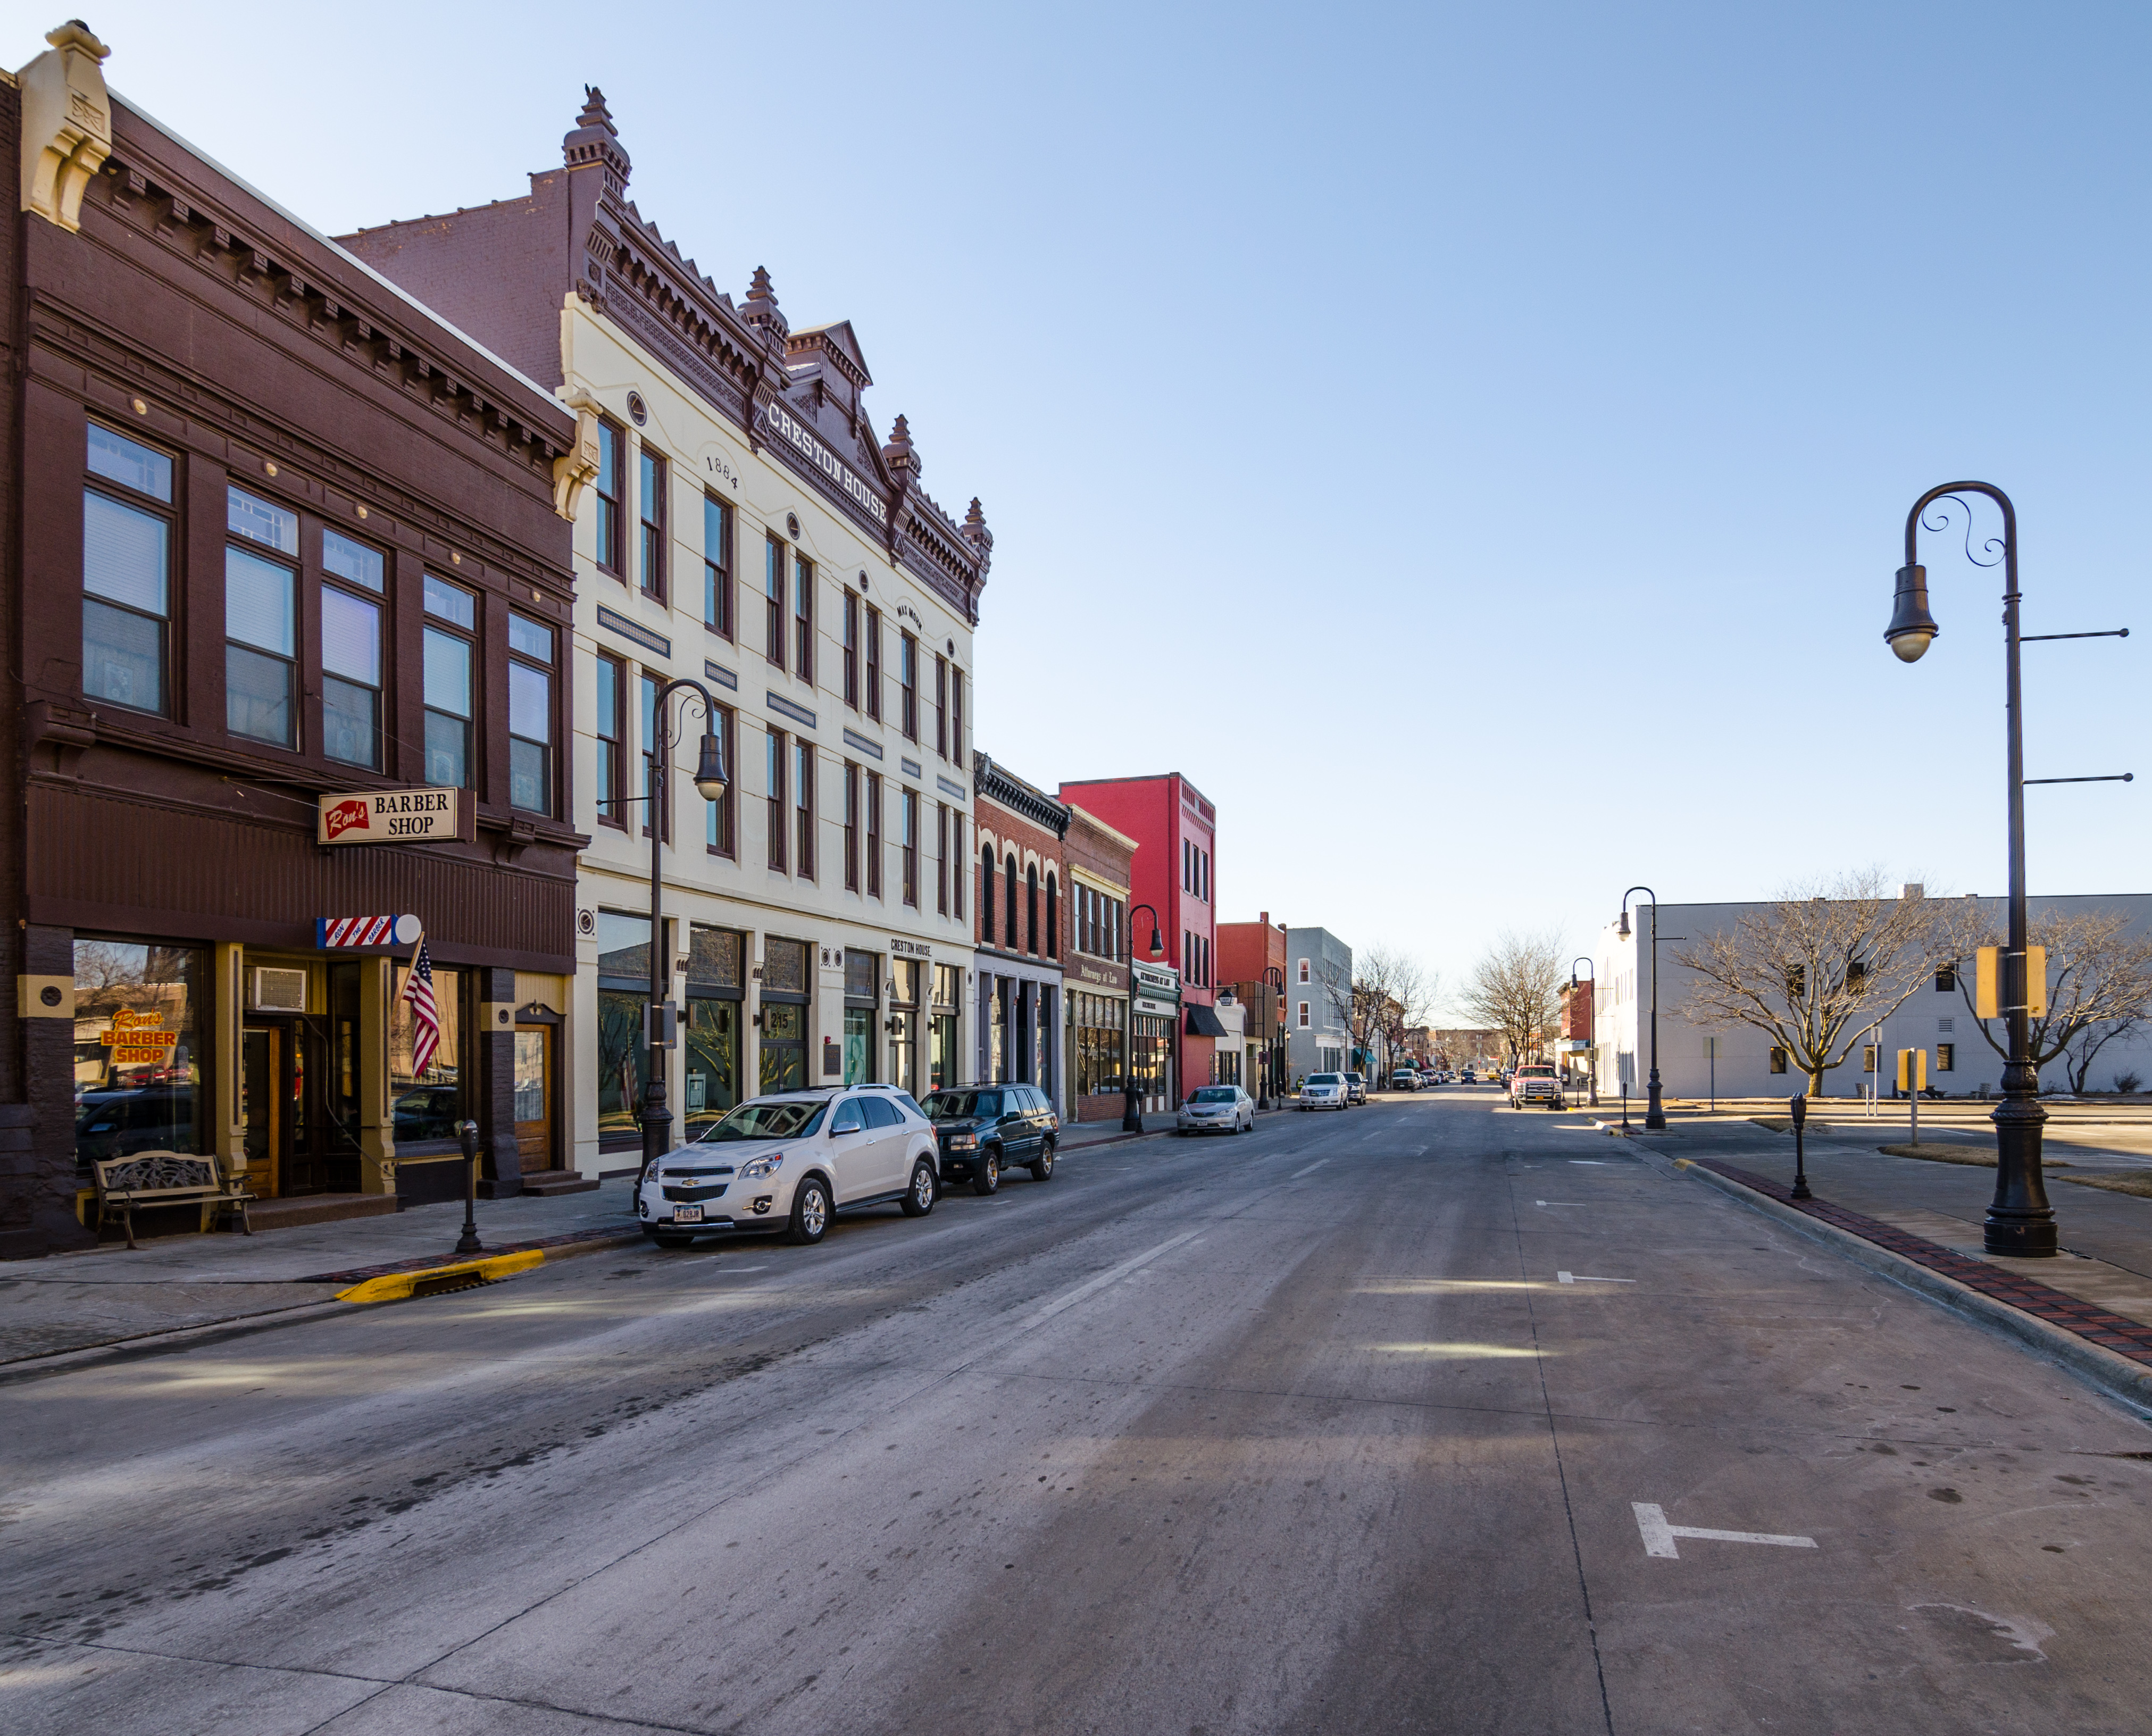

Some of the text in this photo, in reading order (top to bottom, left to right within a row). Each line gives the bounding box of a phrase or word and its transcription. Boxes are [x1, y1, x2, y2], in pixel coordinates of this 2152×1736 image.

[707, 456, 738, 490] 1884
[768, 403, 887, 524] CRESTON HOUSE
[897, 605, 907, 617] MAX
[374, 794, 449, 814] BARBER
[328, 802, 366, 833] Ron's
[388, 816, 434, 835] SHOP
[334, 923, 345, 940] RON
[352, 924, 362, 939] THE
[368, 917, 385, 943] BARBER
[891, 938, 914, 954] CRESTON
[1080, 964, 1101, 983] Attorneys
[1103, 972, 1107, 982] at
[112, 1007, 164, 1031] Ron's
[771, 1012, 789, 1029] 215
[101, 1030, 177, 1046] BARBER
[114, 1047, 165, 1063] SHOP
